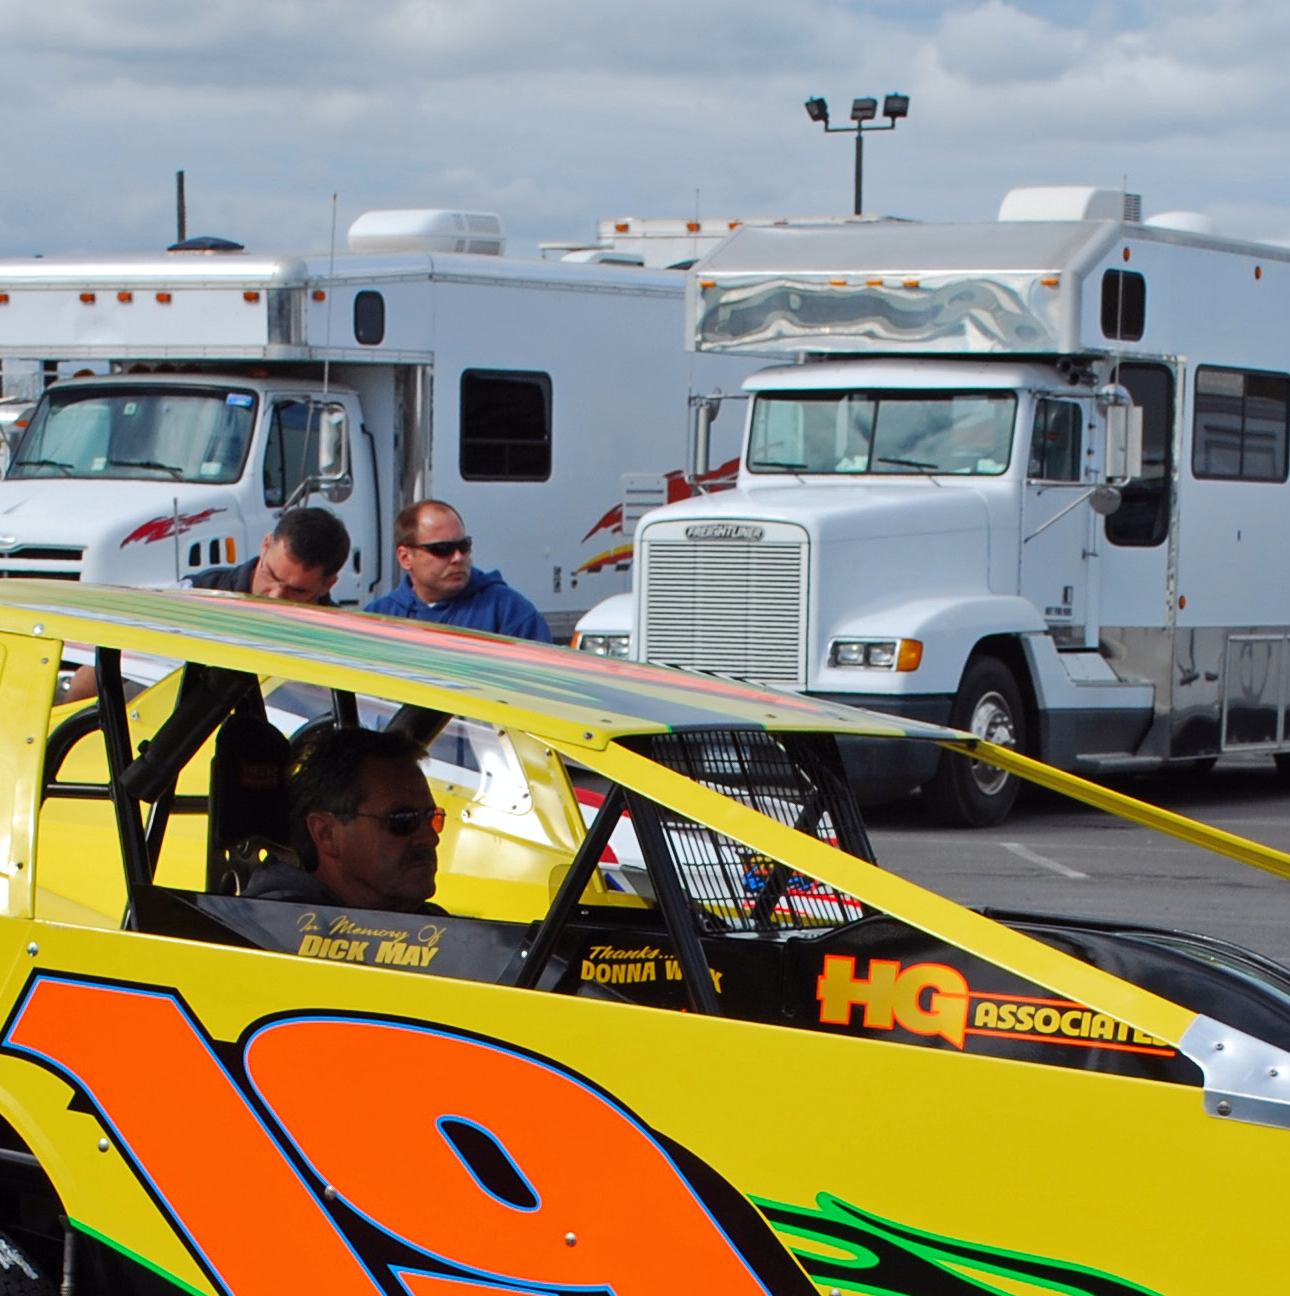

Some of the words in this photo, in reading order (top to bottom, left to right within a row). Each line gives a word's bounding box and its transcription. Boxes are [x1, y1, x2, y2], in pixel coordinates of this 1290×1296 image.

[296, 912, 320, 932] In
[329, 915, 409, 943] Memory
[417, 924, 447, 947] Of
[298, 934, 369, 962] DICK
[375, 940, 439, 967] MAY
[580, 959, 656, 984] DONNA
[816, 953, 969, 1050] HG
[975, 1002, 1170, 1047] ASSOCIAT
